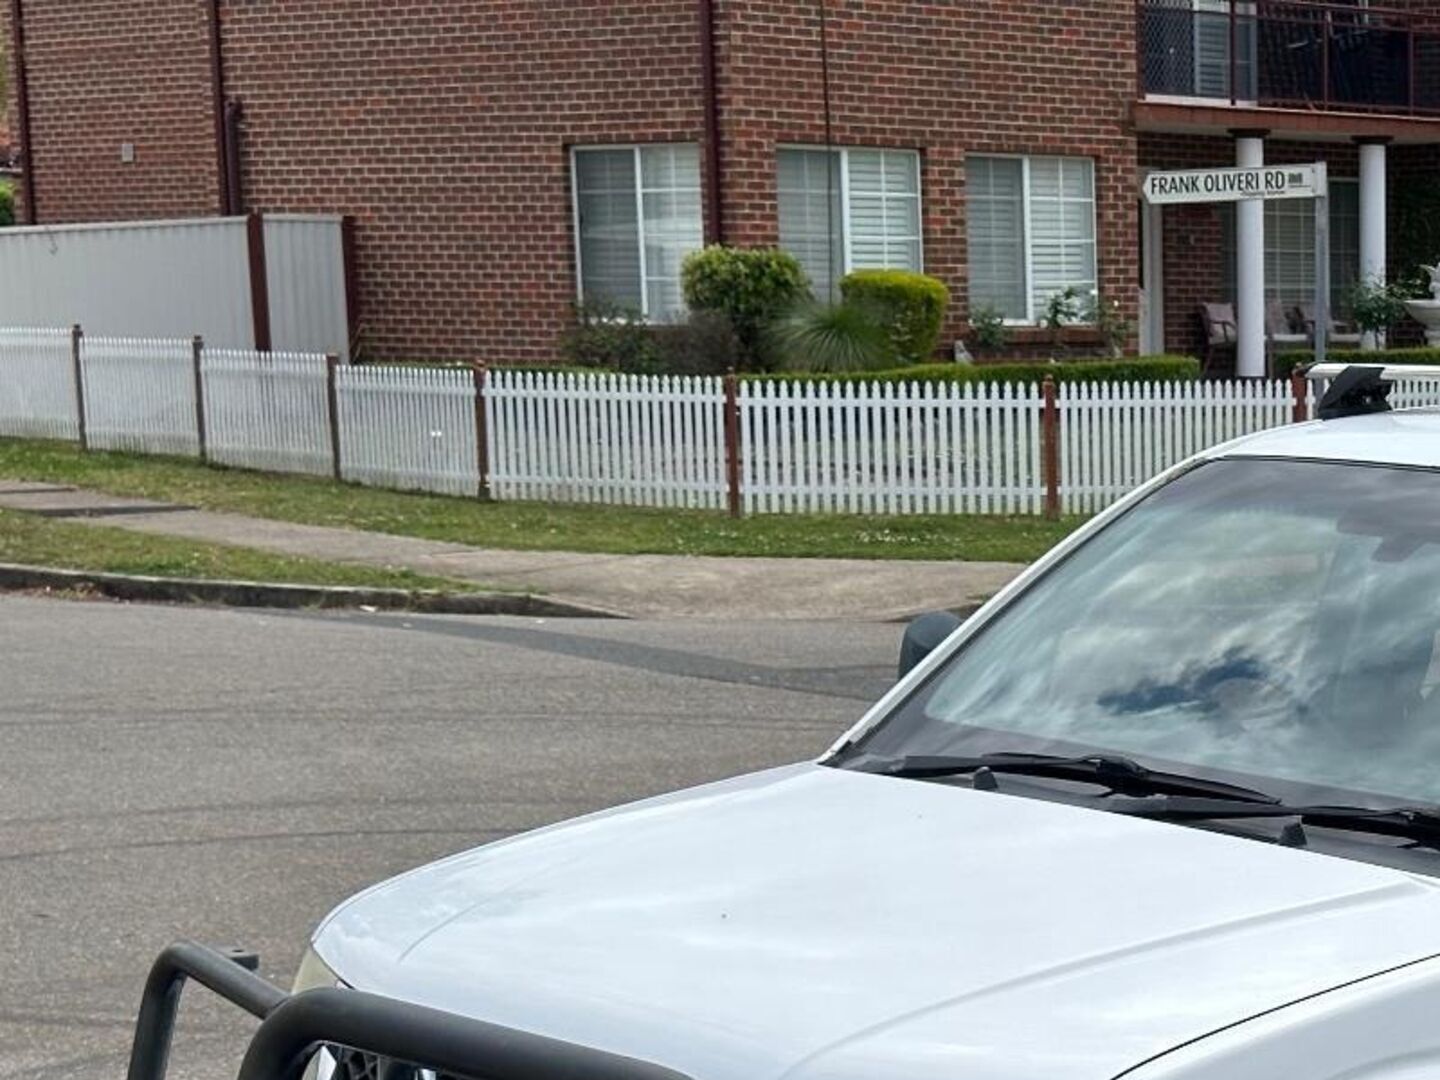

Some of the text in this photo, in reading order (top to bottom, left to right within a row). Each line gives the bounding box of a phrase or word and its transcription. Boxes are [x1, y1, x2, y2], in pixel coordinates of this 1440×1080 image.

[1150, 175, 1200, 196] FRANK
[1203, 172, 1260, 193] OLIVERI
[1264, 170, 1286, 190] RD
